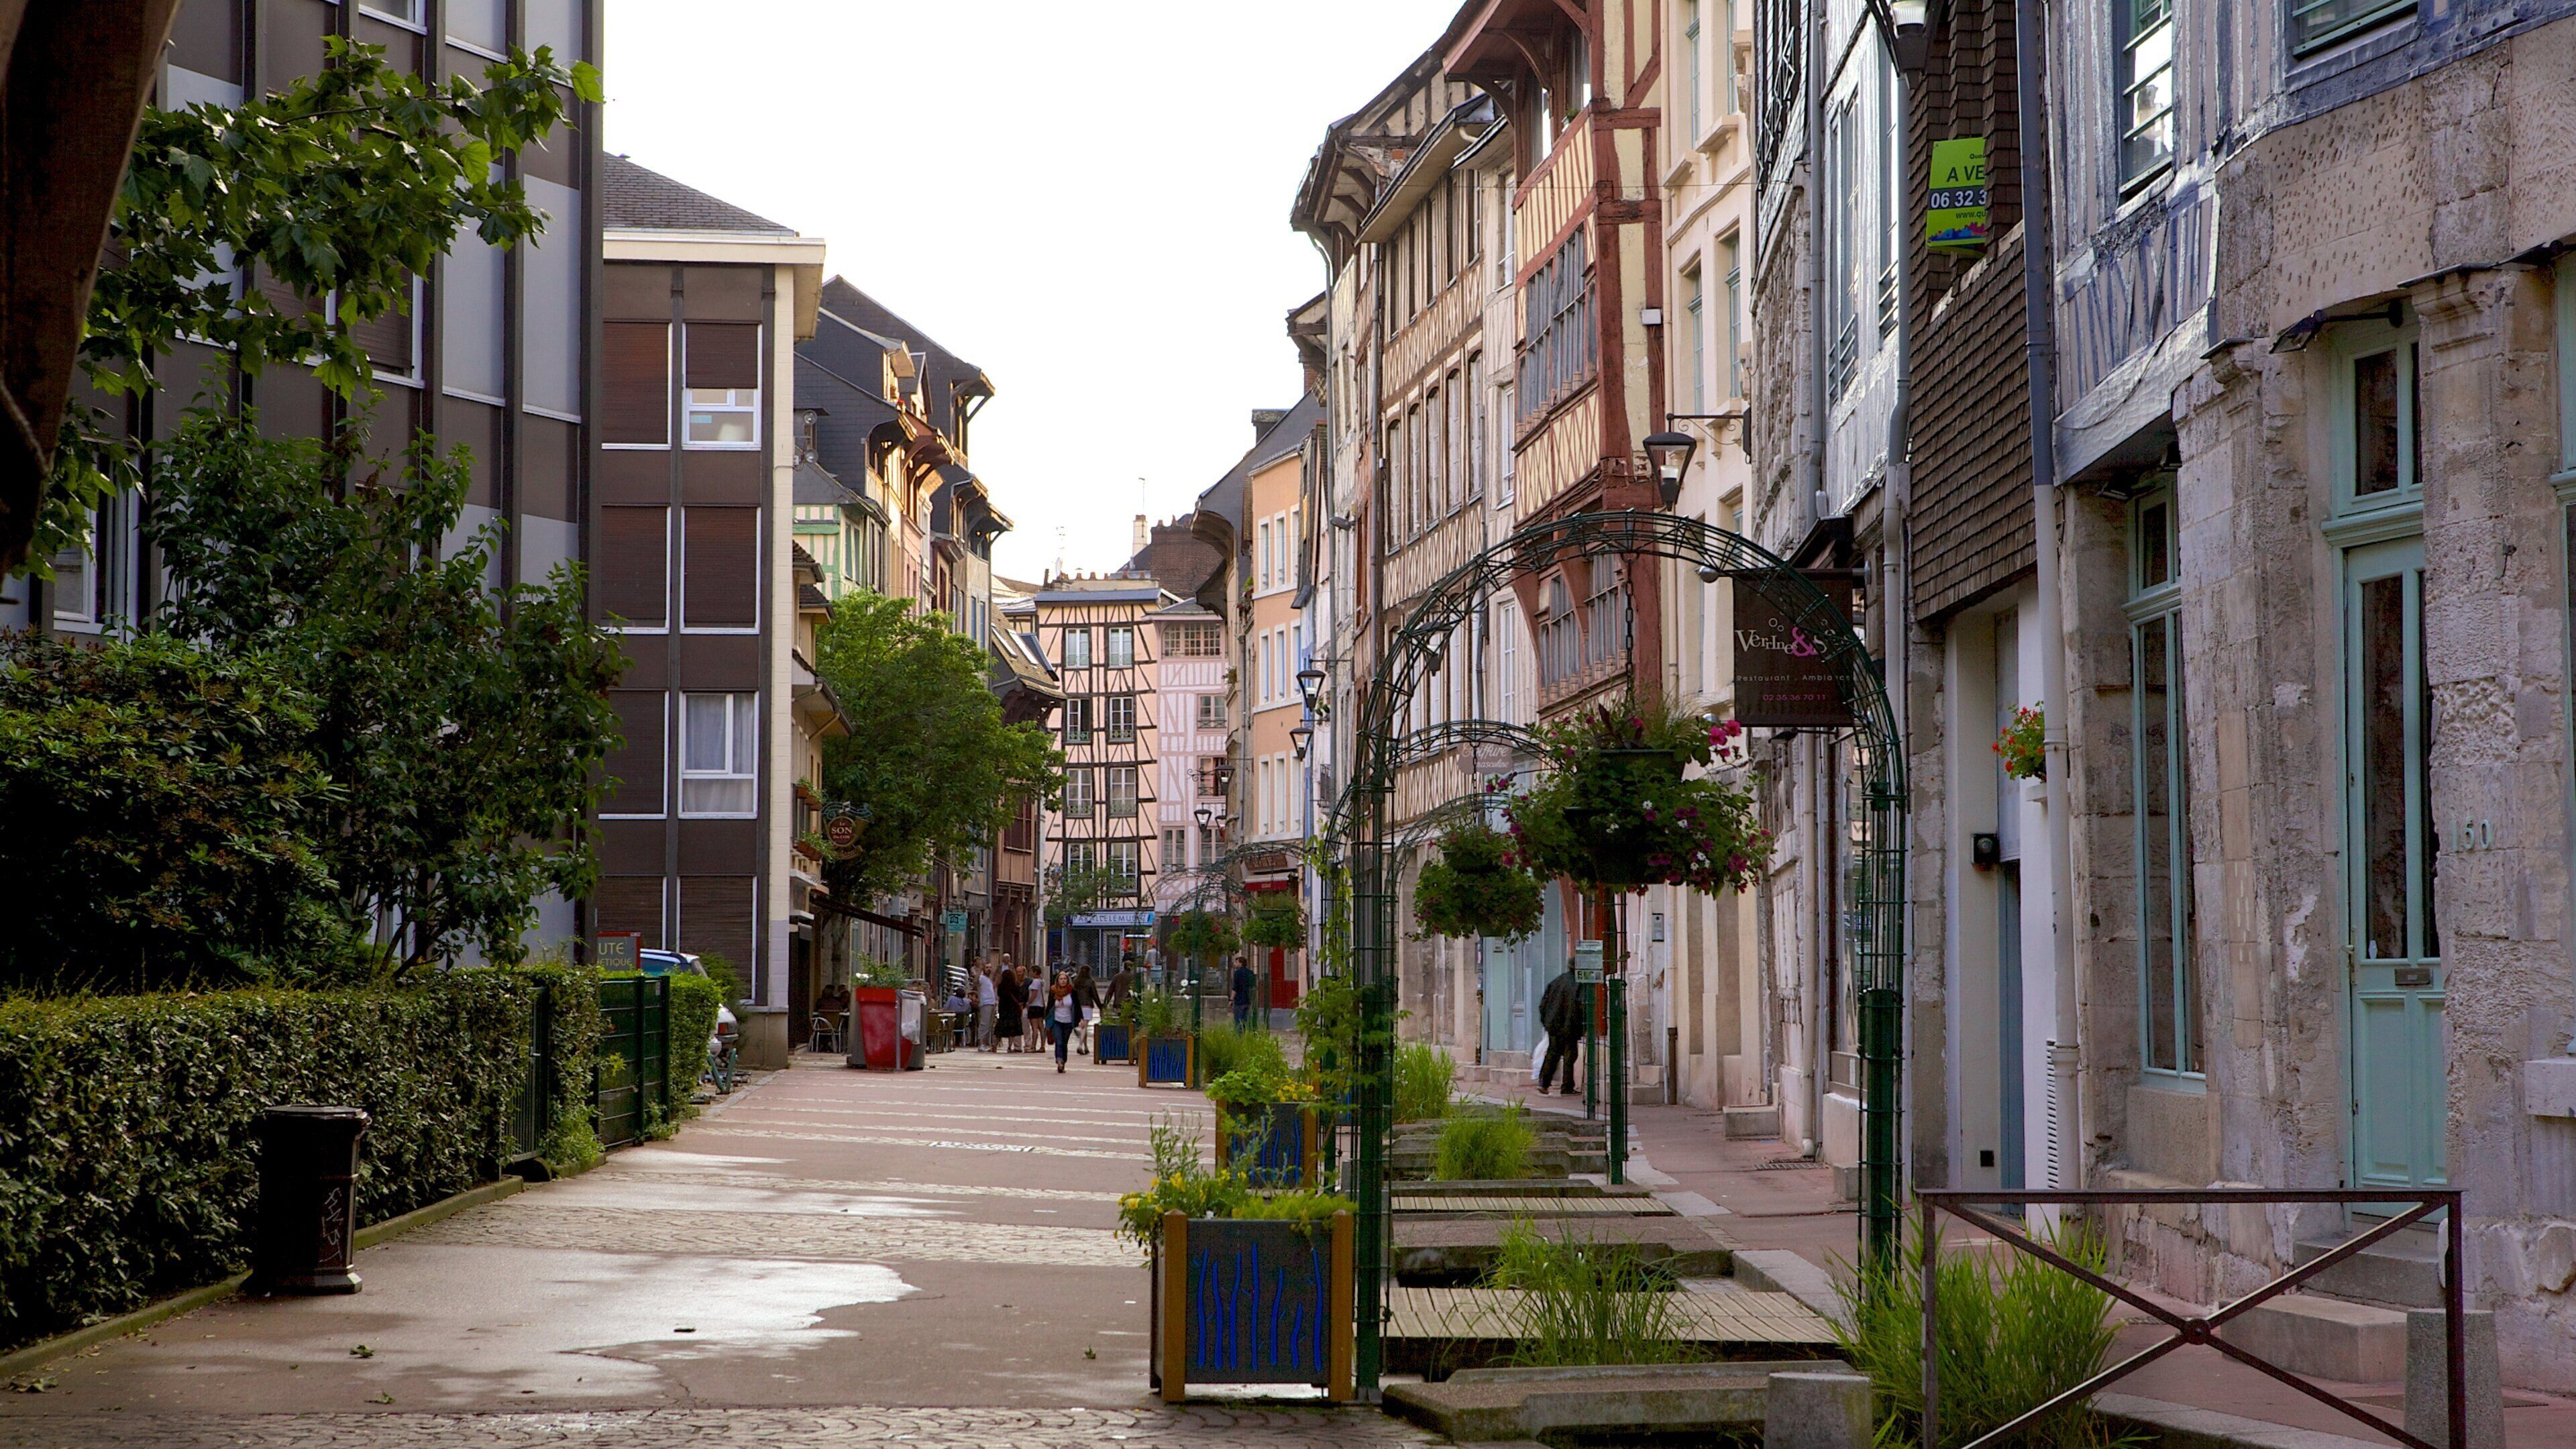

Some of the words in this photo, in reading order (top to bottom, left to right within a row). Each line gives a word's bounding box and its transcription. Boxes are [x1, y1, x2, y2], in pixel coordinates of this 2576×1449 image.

[1946, 166, 1959, 182] A
[1964, 165, 1985, 181] VE
[1931, 192, 1950, 209] 06
[1954, 191, 1974, 207] 32
[1978, 189, 1988, 205] 3
[1791, 627, 1819, 657] &
[2451, 816, 2491, 851] 150
[598, 942, 625, 955] UTE
